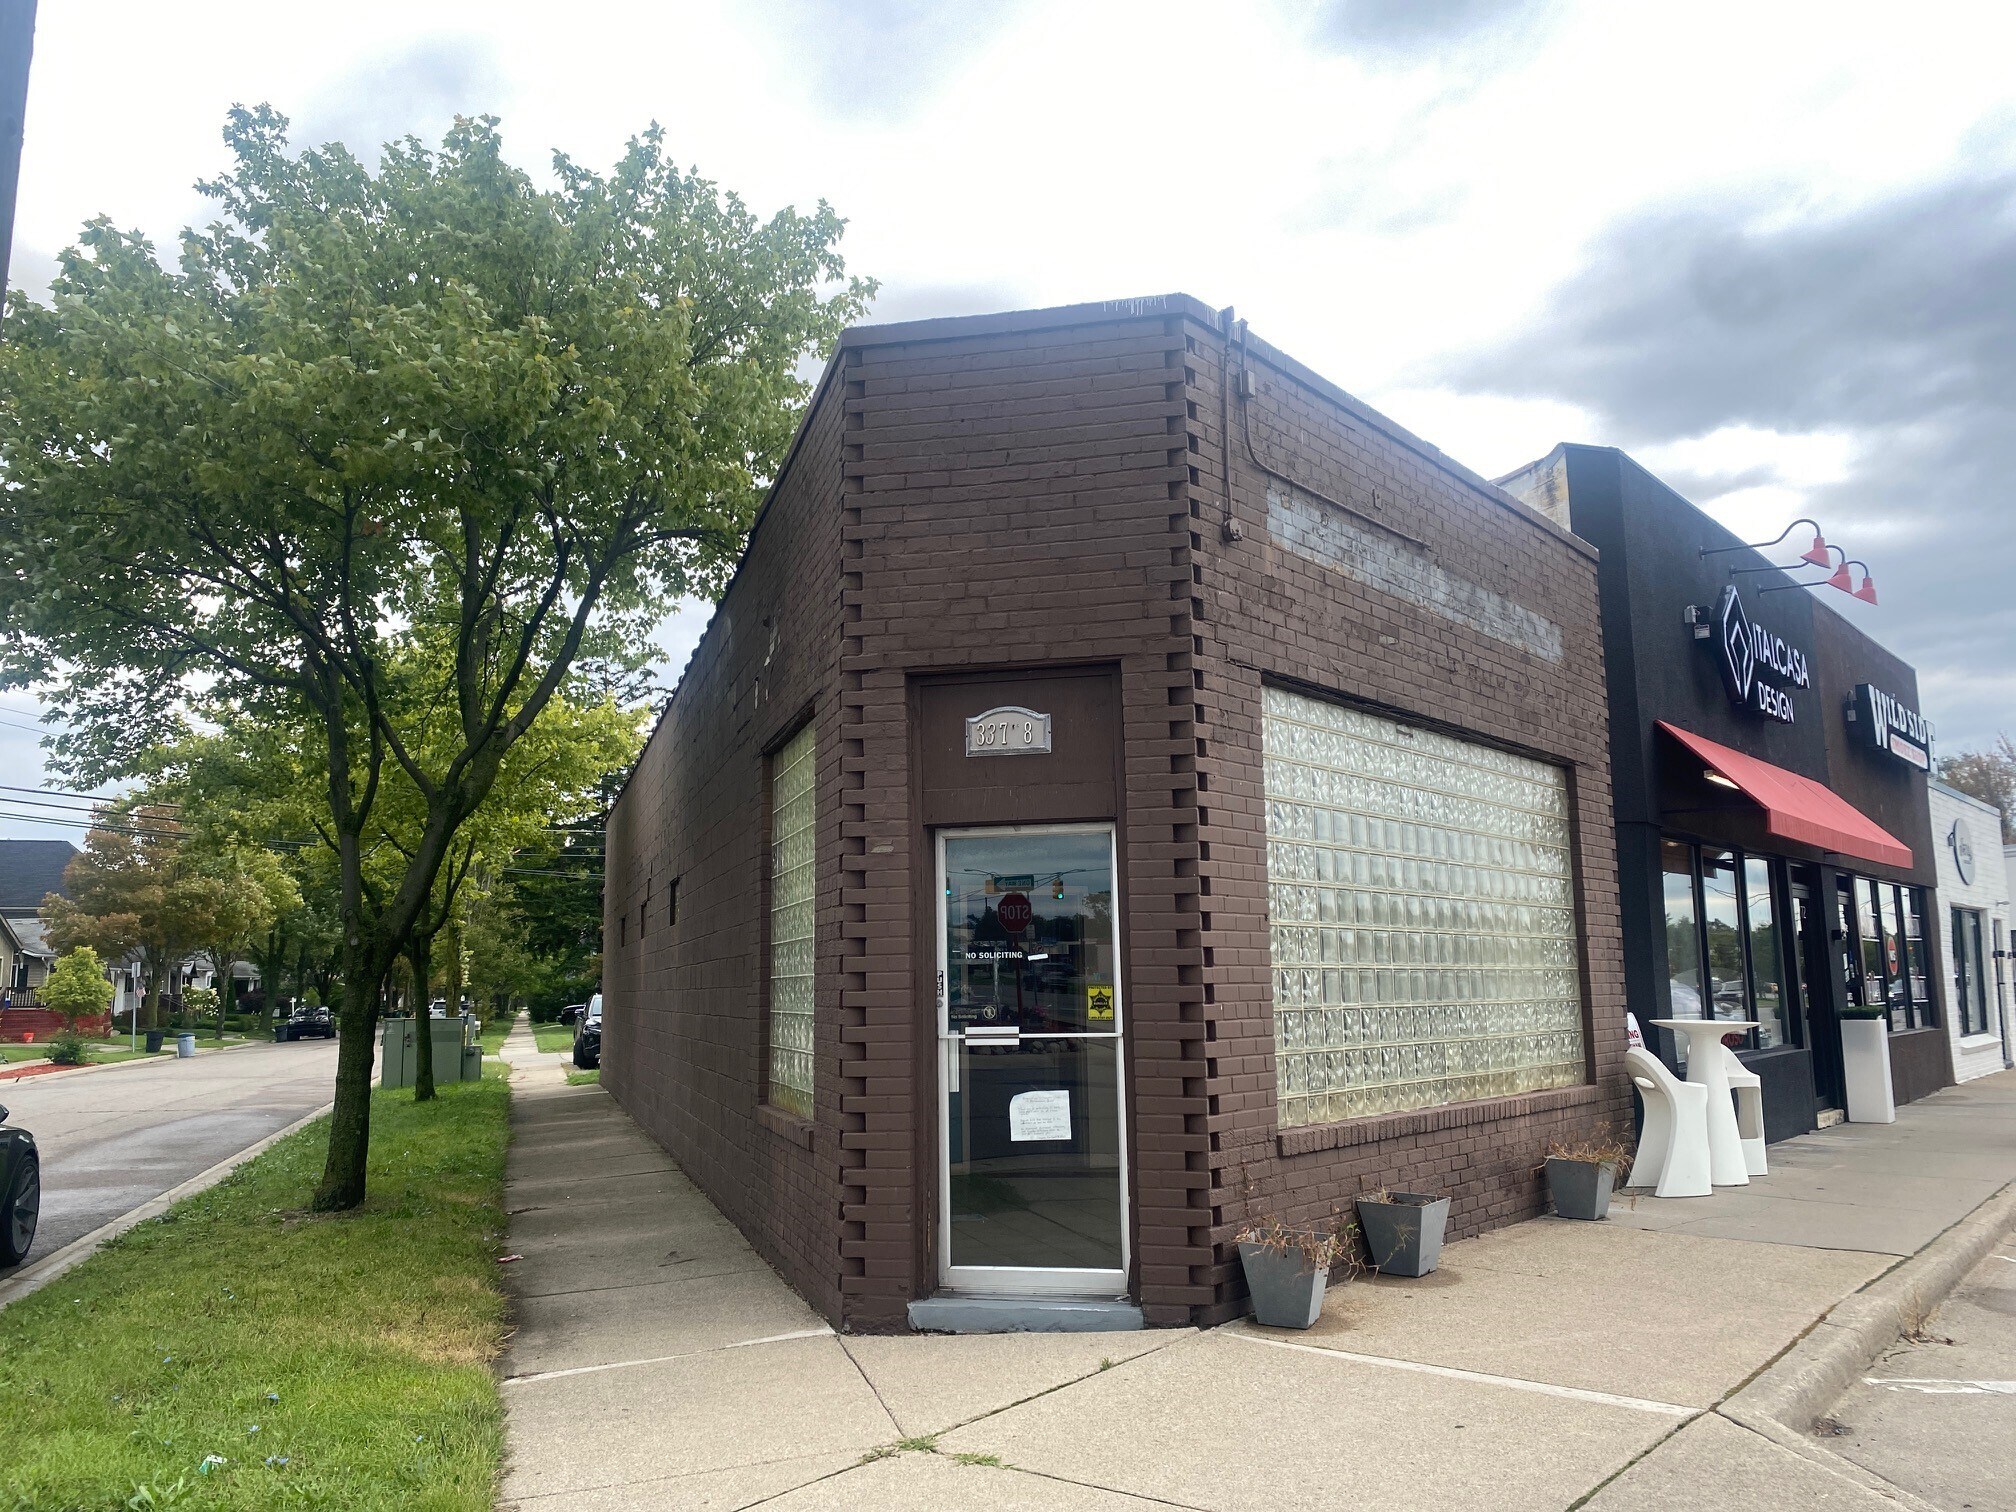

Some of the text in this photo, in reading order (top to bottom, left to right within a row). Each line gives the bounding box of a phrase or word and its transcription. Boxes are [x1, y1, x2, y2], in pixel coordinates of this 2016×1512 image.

[1752, 622, 1810, 689] ITALCASA
[1757, 681, 1795, 723] DESIGN
[979, 951, 1023, 959] SOLICITING
